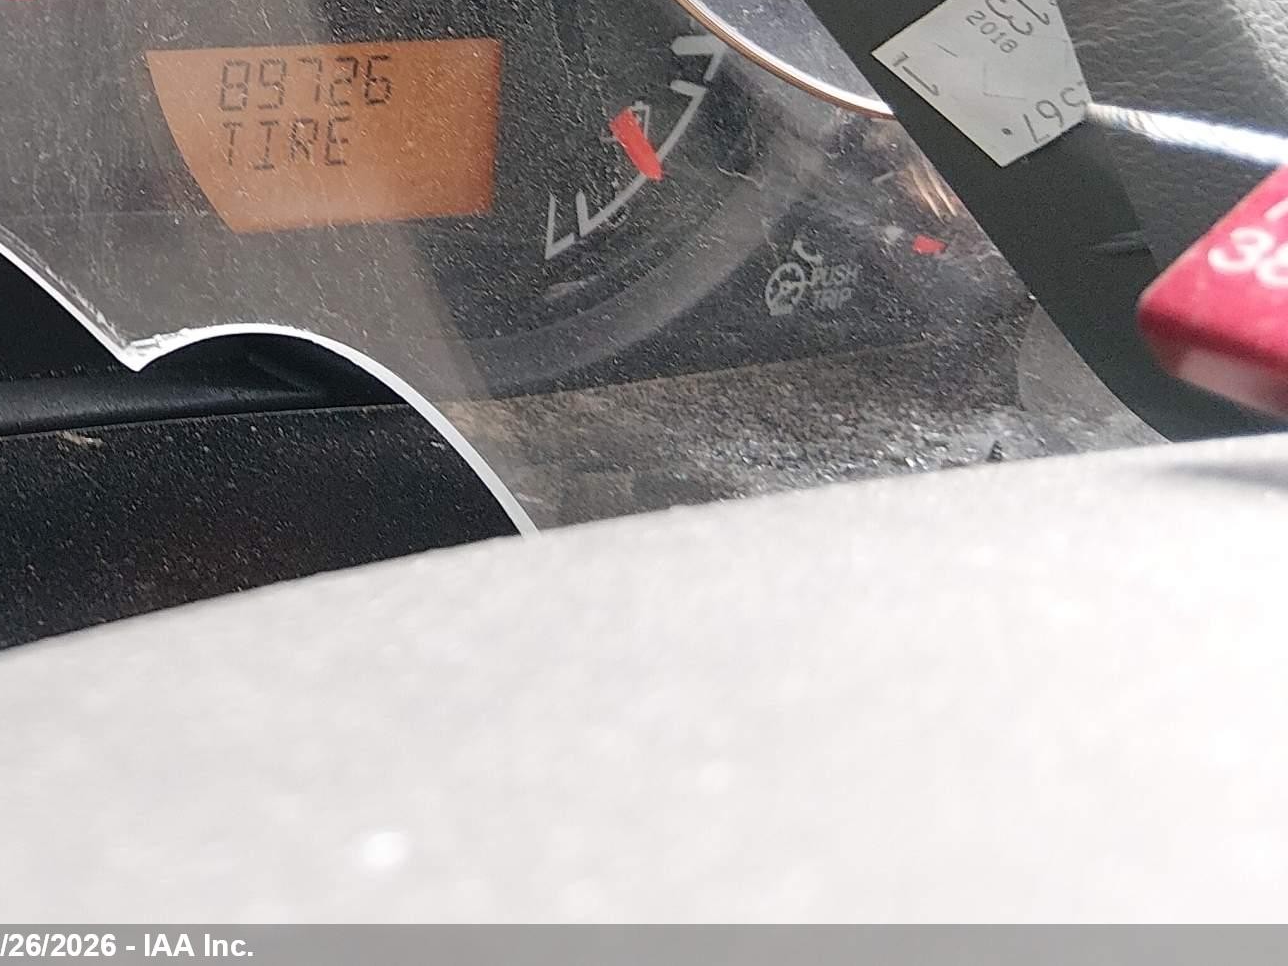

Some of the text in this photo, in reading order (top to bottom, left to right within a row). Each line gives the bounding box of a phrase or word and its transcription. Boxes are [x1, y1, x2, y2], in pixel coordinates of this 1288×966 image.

[966, 10, 1018, 53] 2018
[218, 55, 392, 112] 89726
[222, 117, 350, 170] TIRE
[810, 264, 859, 287] PUSH
